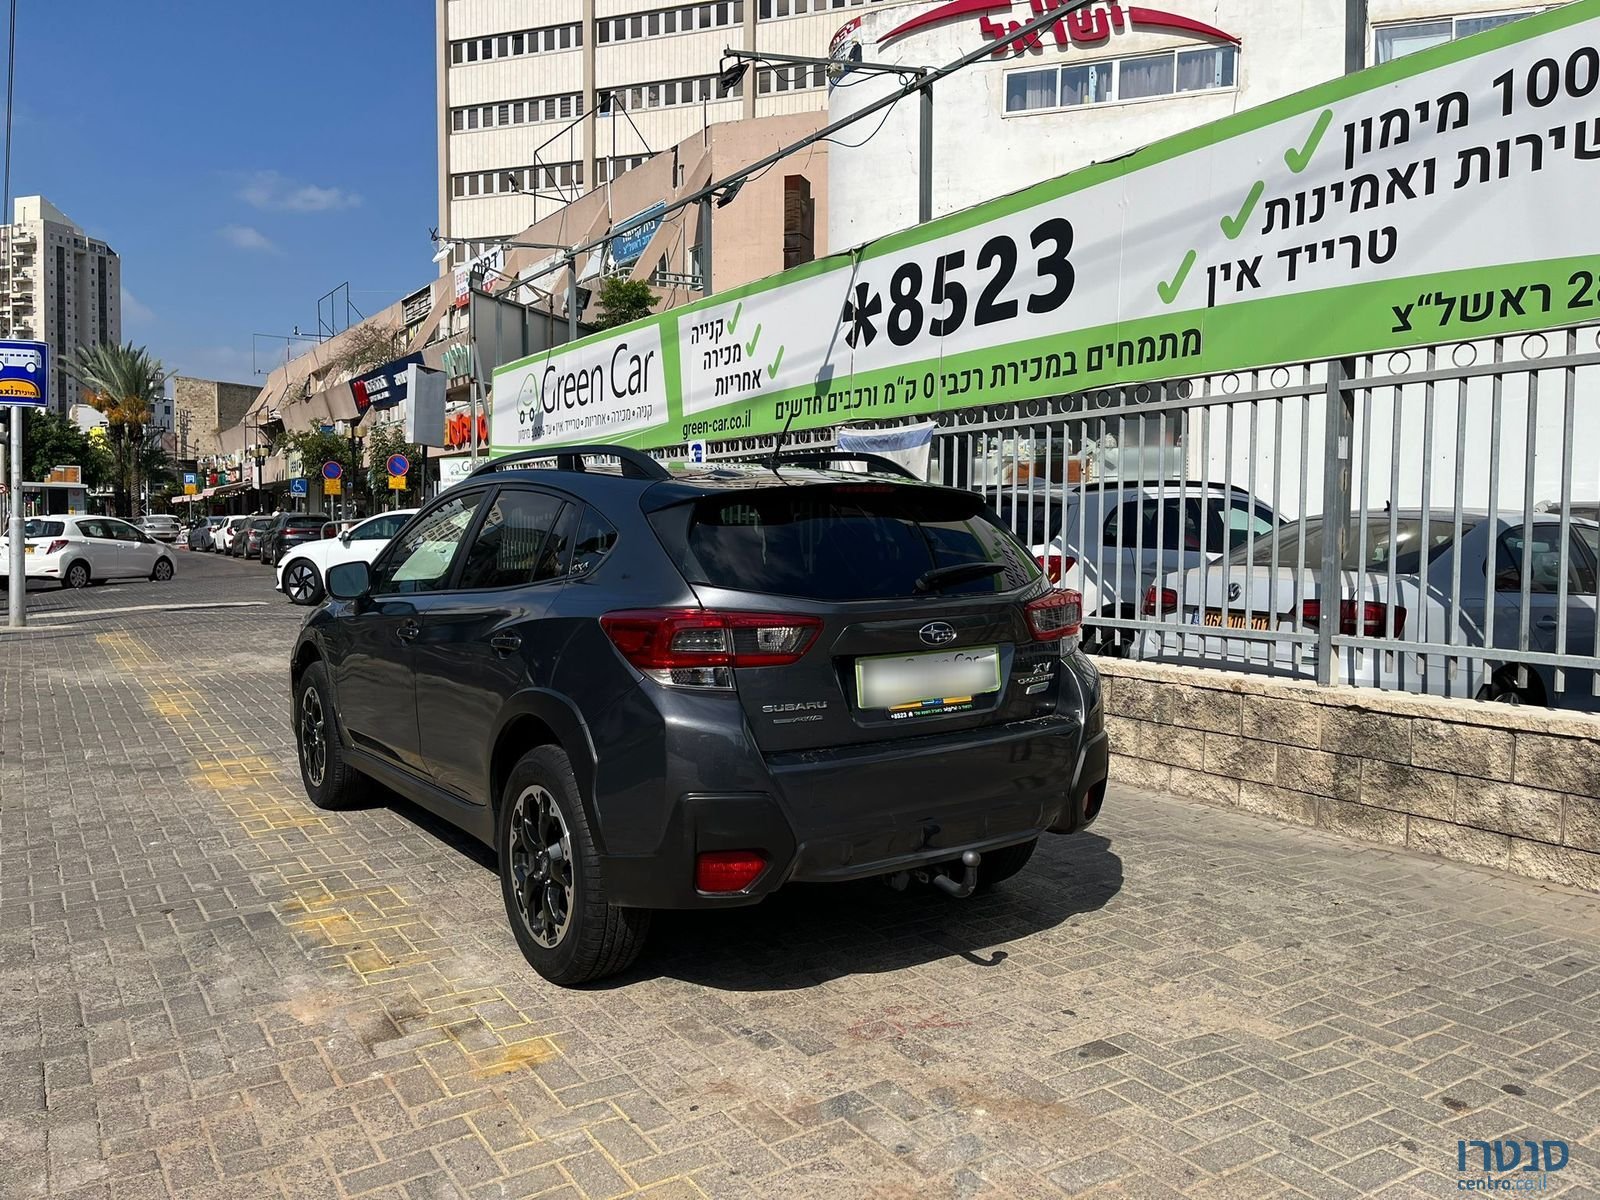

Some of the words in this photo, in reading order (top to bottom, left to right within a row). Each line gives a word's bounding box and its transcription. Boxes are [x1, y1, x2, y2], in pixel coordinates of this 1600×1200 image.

[979, 5, 1124, 53] ישראל
[1344, 90, 1470, 170] מימון
[1261, 157, 1436, 236] ואמינות
[1277, 225, 1398, 283] טרייד
[1206, 255, 1264, 307] אין
[1567, 271, 1600, 309] 2
[691, 318, 724, 345] קנייה
[1086, 328, 1202, 372] מתמחים
[703, 343, 742, 370] מכירה
[990, 351, 1078, 389] במכירת
[541, 364, 604, 414] Green
[610, 343, 655, 399] Car
[714, 369, 762, 397] אחריות
[942, 368, 984, 396] רכבי
[775, 396, 822, 420] חדשים
[828, 385, 879, 412] ורכבים
[682, 409, 752, 440] green-car.co.il
[762, 701, 828, 713] SUBARU
